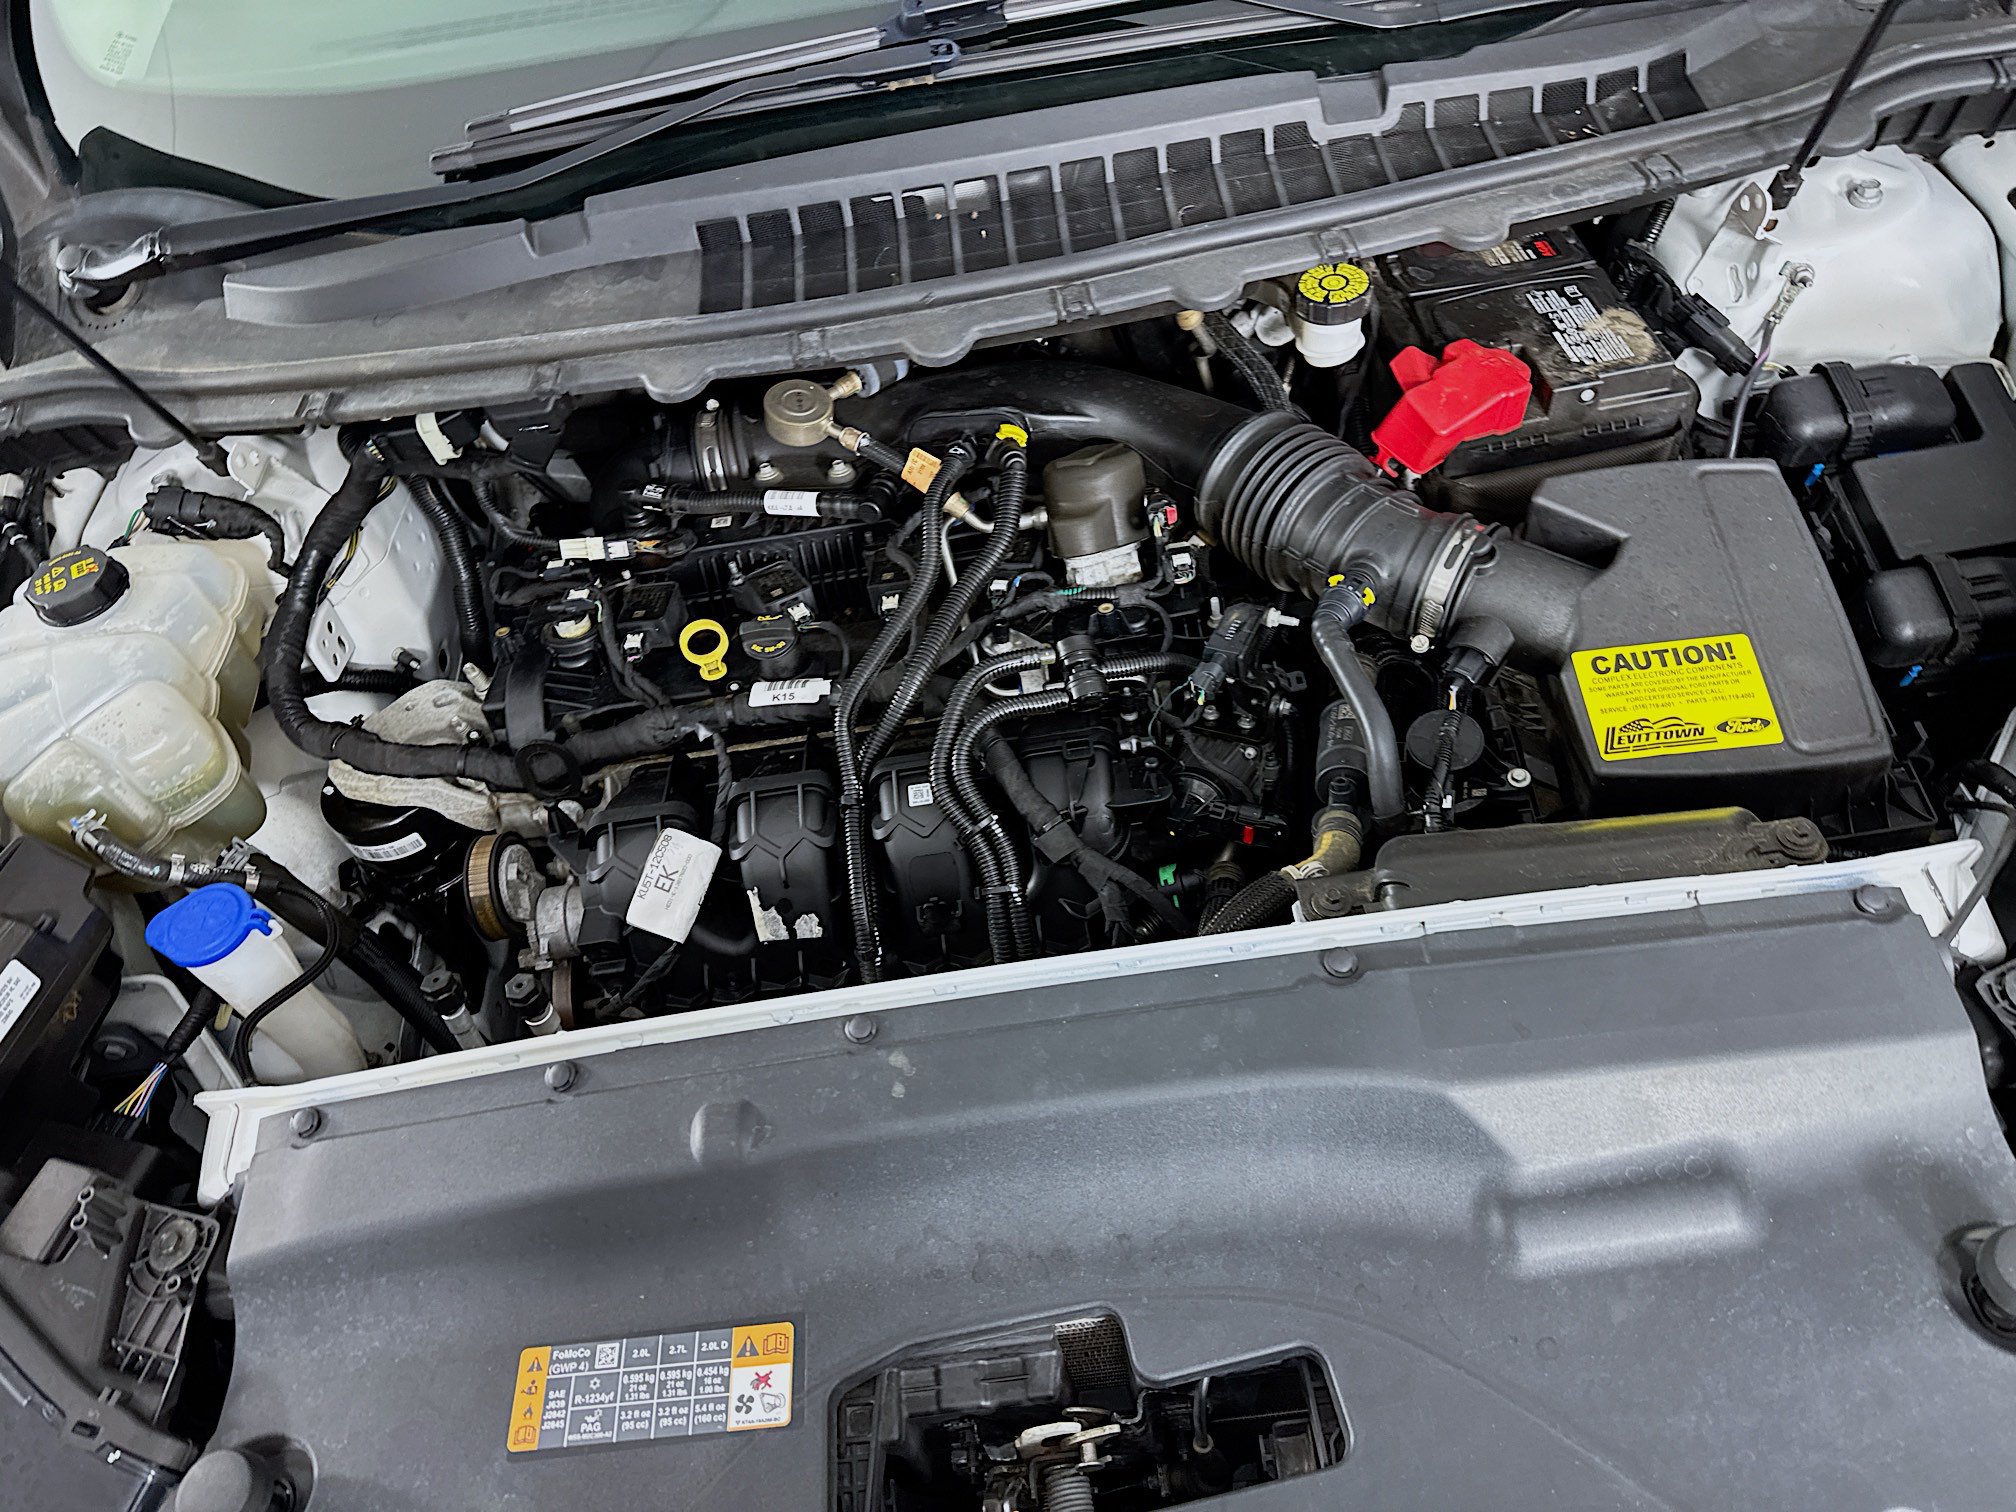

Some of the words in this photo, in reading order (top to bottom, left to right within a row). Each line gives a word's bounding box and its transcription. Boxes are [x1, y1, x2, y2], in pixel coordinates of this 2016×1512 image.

[1591, 642, 1736, 674] CAUTION!
[1592, 674, 1631, 684] COMPLEX
[1634, 667, 1684, 680] ELECTRONIC
[1686, 662, 1742, 674] COMPONENTS
[1644, 678, 1674, 686] COVERED
[1700, 670, 1752, 680] MANUFACTURER
[772, 692, 795, 702] K15
[1605, 690, 1640, 698] WARRANTY
[1644, 692, 1676, 701] CERTIFIED
[1600, 706, 1627, 714] SERVICE
[1726, 718, 1764, 734] Ford
[654, 865, 679, 892] EK
[669, 1345, 688, 1354] 2.7L
[701, 1342, 720, 1352] 2.0L
[720, 1340, 728, 1350] D
[552, 1348, 590, 1360] FoMoCo
[632, 1348, 651, 1358] 2.0L
[549, 1362, 577, 1375] (GWP
[578, 1361, 590, 1372] 4)
[719, 1366, 730, 1376] kg
[644, 1372, 655, 1384] kg
[682, 1369, 692, 1380] kg
[548, 1390, 566, 1400] SAE
[574, 1391, 614, 1404] R-1234yf
[674, 1416, 687, 1426] cc)
[713, 1413, 726, 1422] cc)
[580, 1422, 602, 1433] PAG
[636, 1420, 649, 1430] cc)
